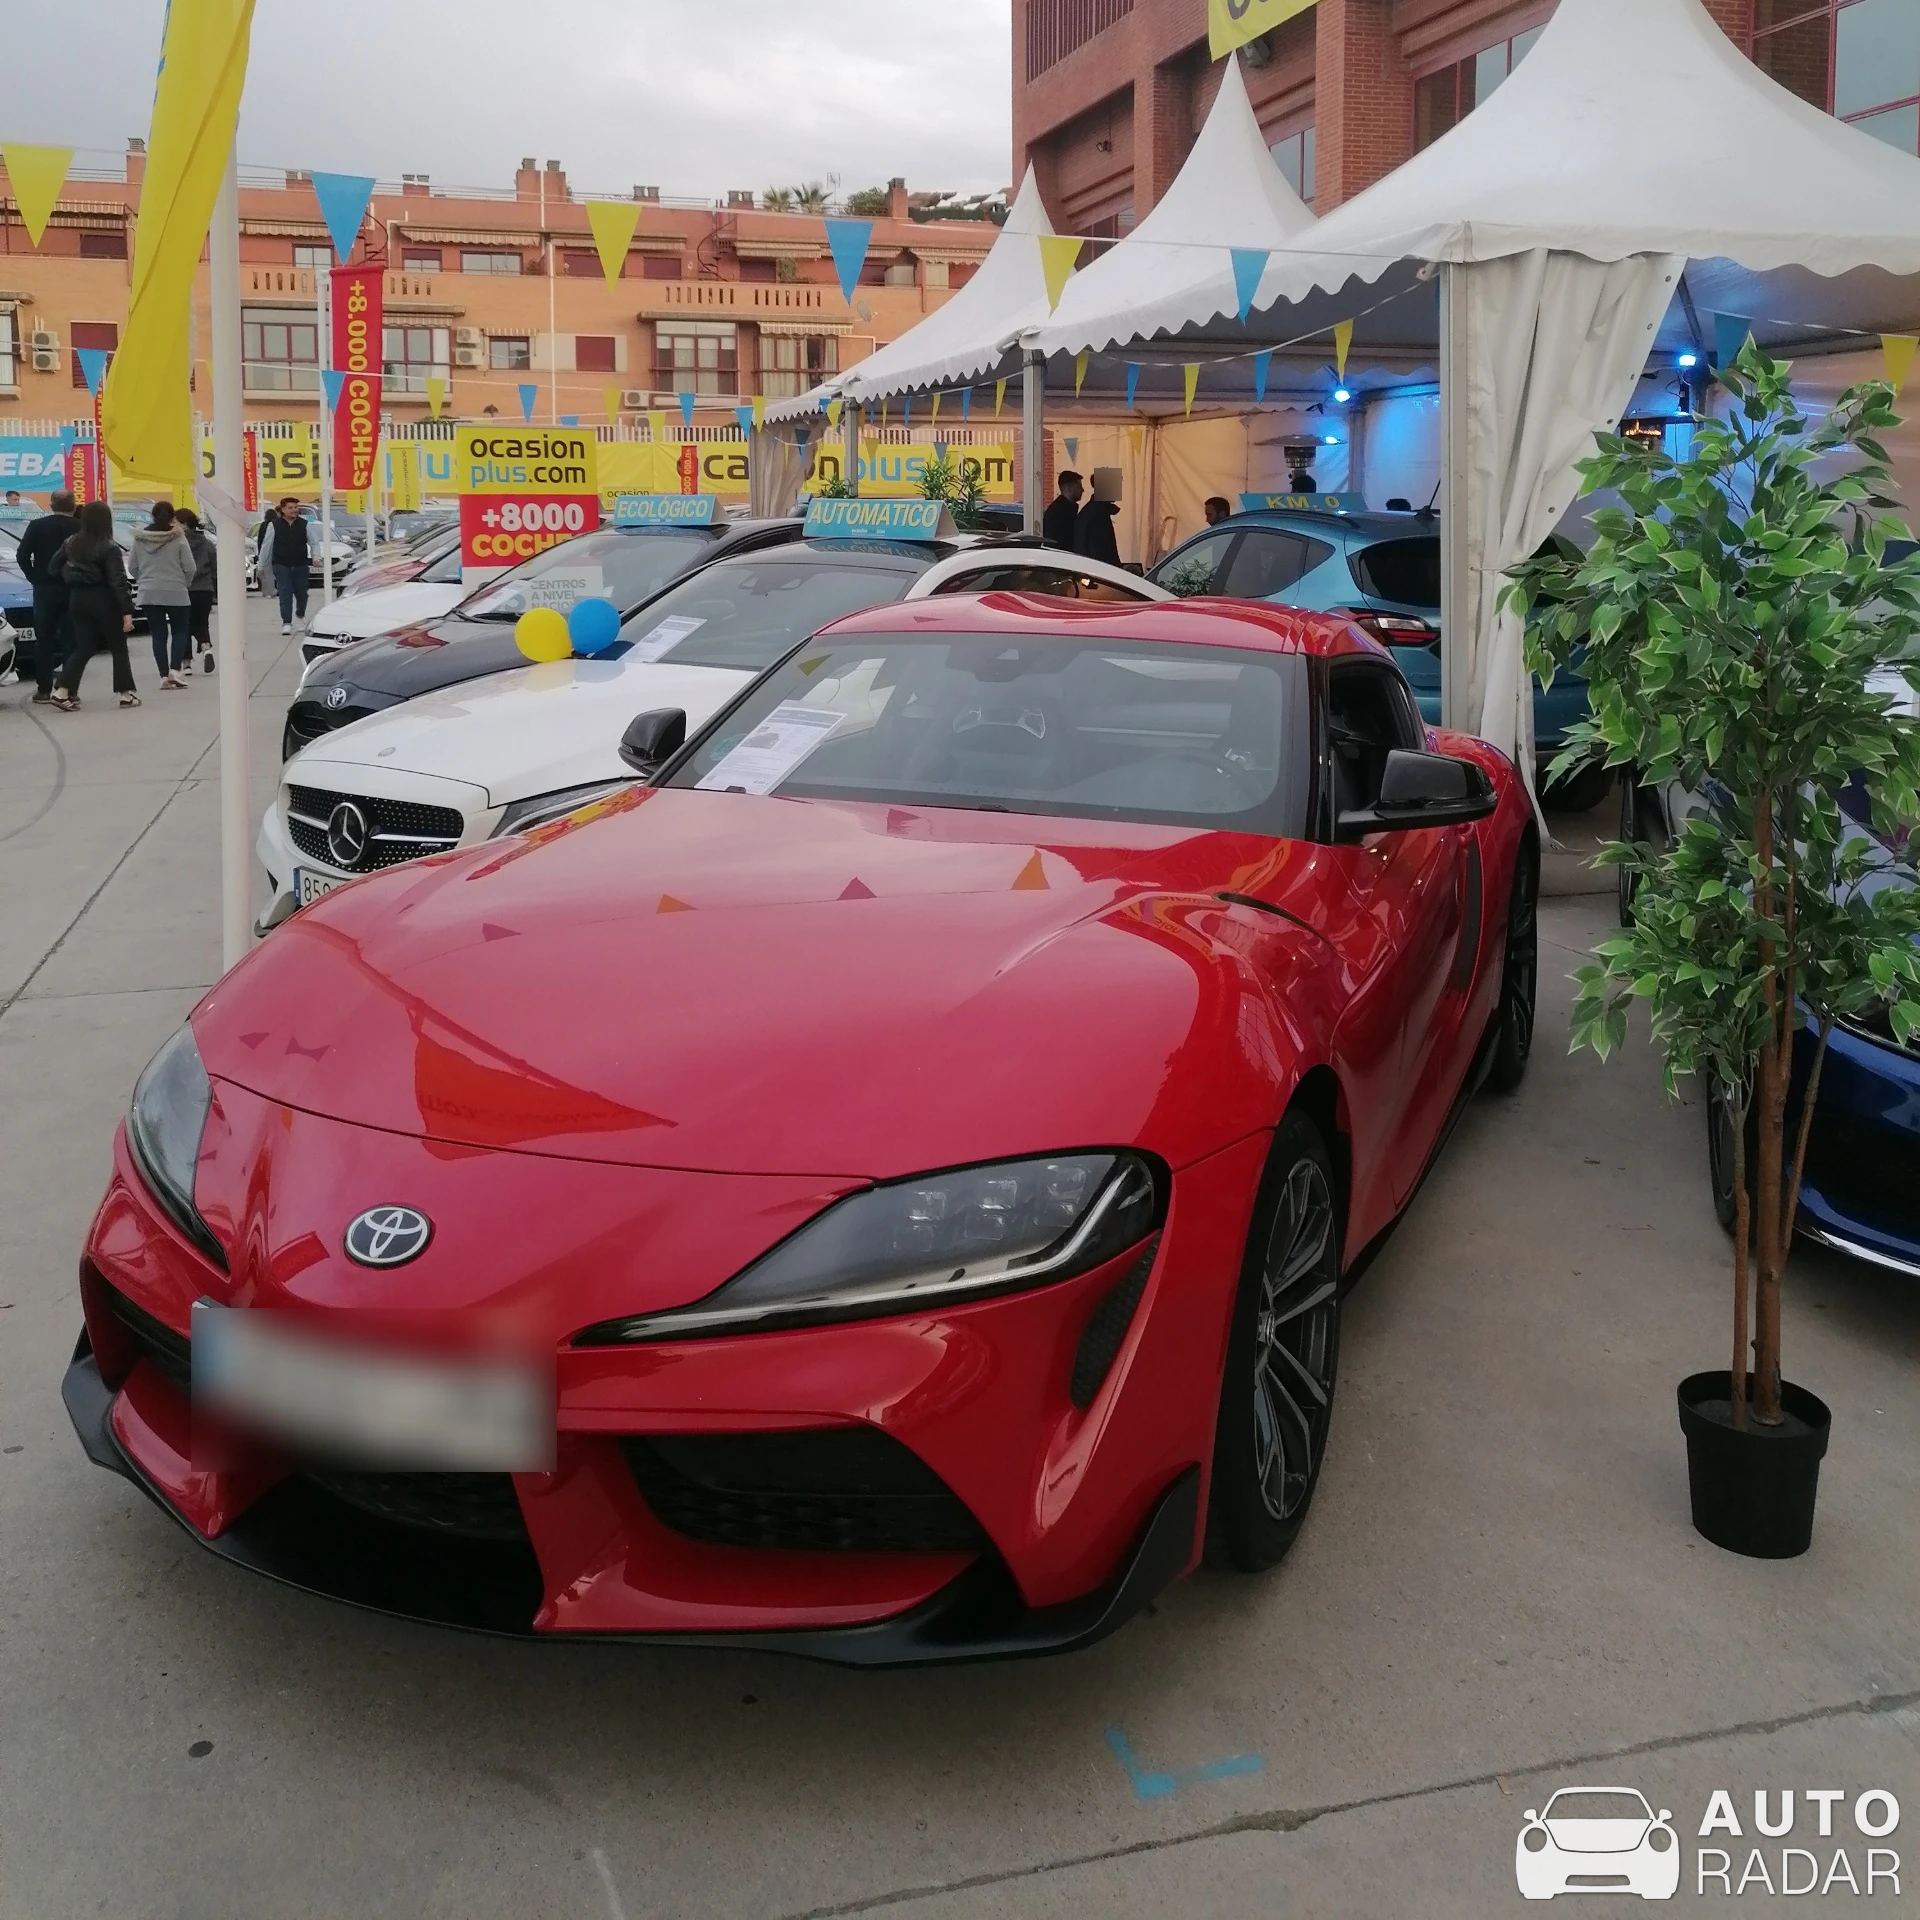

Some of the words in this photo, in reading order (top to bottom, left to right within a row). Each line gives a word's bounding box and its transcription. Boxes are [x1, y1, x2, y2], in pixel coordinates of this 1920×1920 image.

[347, 280, 368, 372] +8.000
[349, 380, 373, 487] COCHES
[470, 433, 585, 459] ocasion
[470, 460, 586, 489] plus.com
[481, 502, 585, 532] +8000
[617, 496, 708, 518] ECOLÓGICO
[807, 502, 938, 528] AUTOMATICO
[531, 579, 586, 590] CENTROS
[531, 591, 540, 600] A
